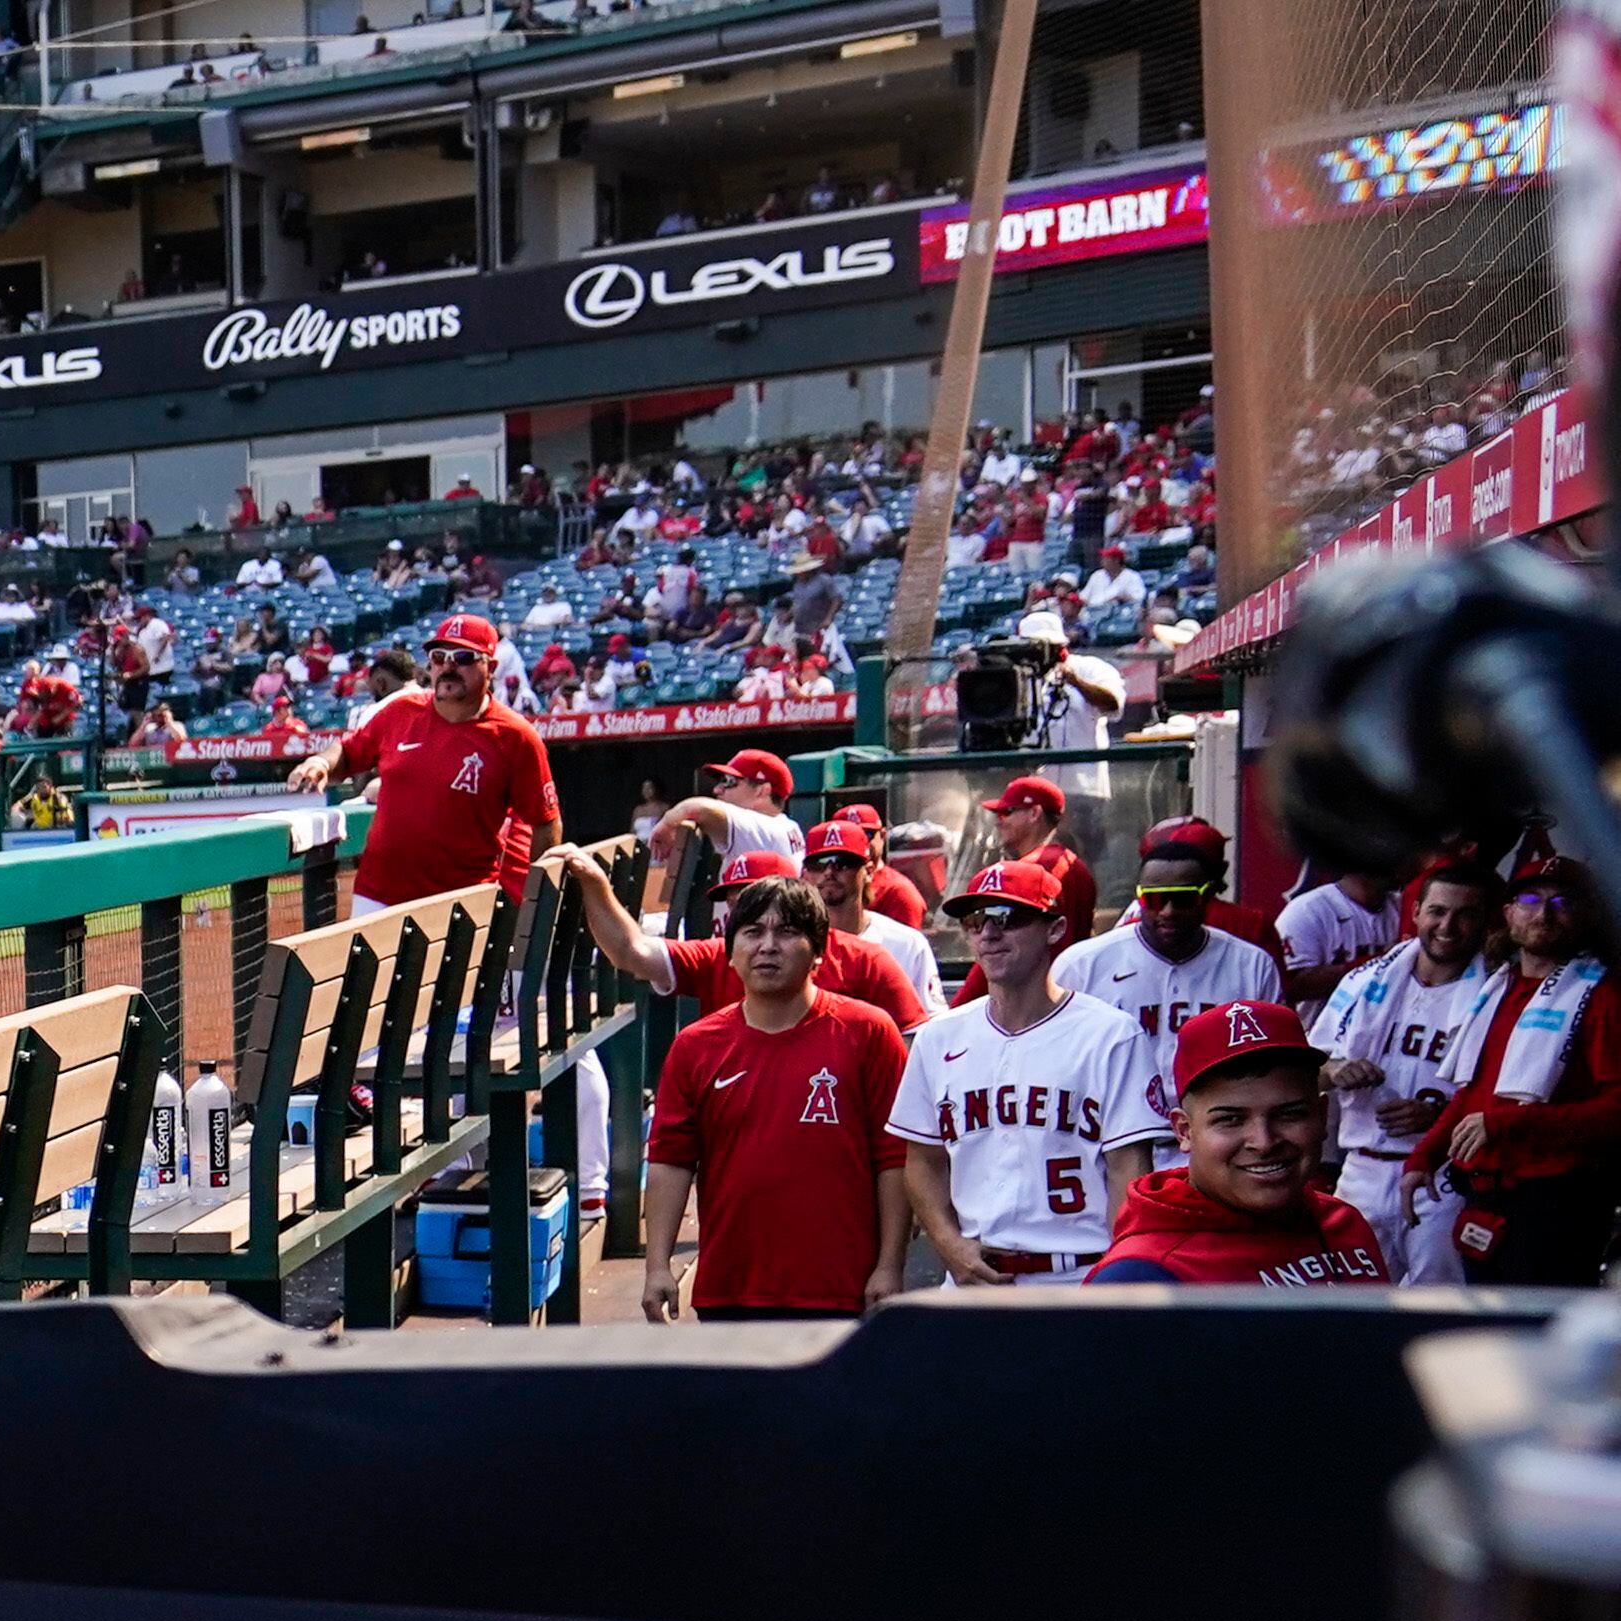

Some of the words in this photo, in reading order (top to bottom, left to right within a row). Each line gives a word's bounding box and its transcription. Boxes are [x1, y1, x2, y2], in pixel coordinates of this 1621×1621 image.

[1057, 189, 1168, 242] BARN
[651, 237, 894, 304] LEXUS
[203, 303, 348, 370] Bally
[349, 304, 461, 349] SPORTS
[198, 738, 273, 759] StateFarm
[156, 1108, 170, 1165] essentia
[212, 1110, 226, 1168] essentia
[936, 1084, 1102, 1146] ANGELS
[1046, 1156, 1087, 1215] 5
